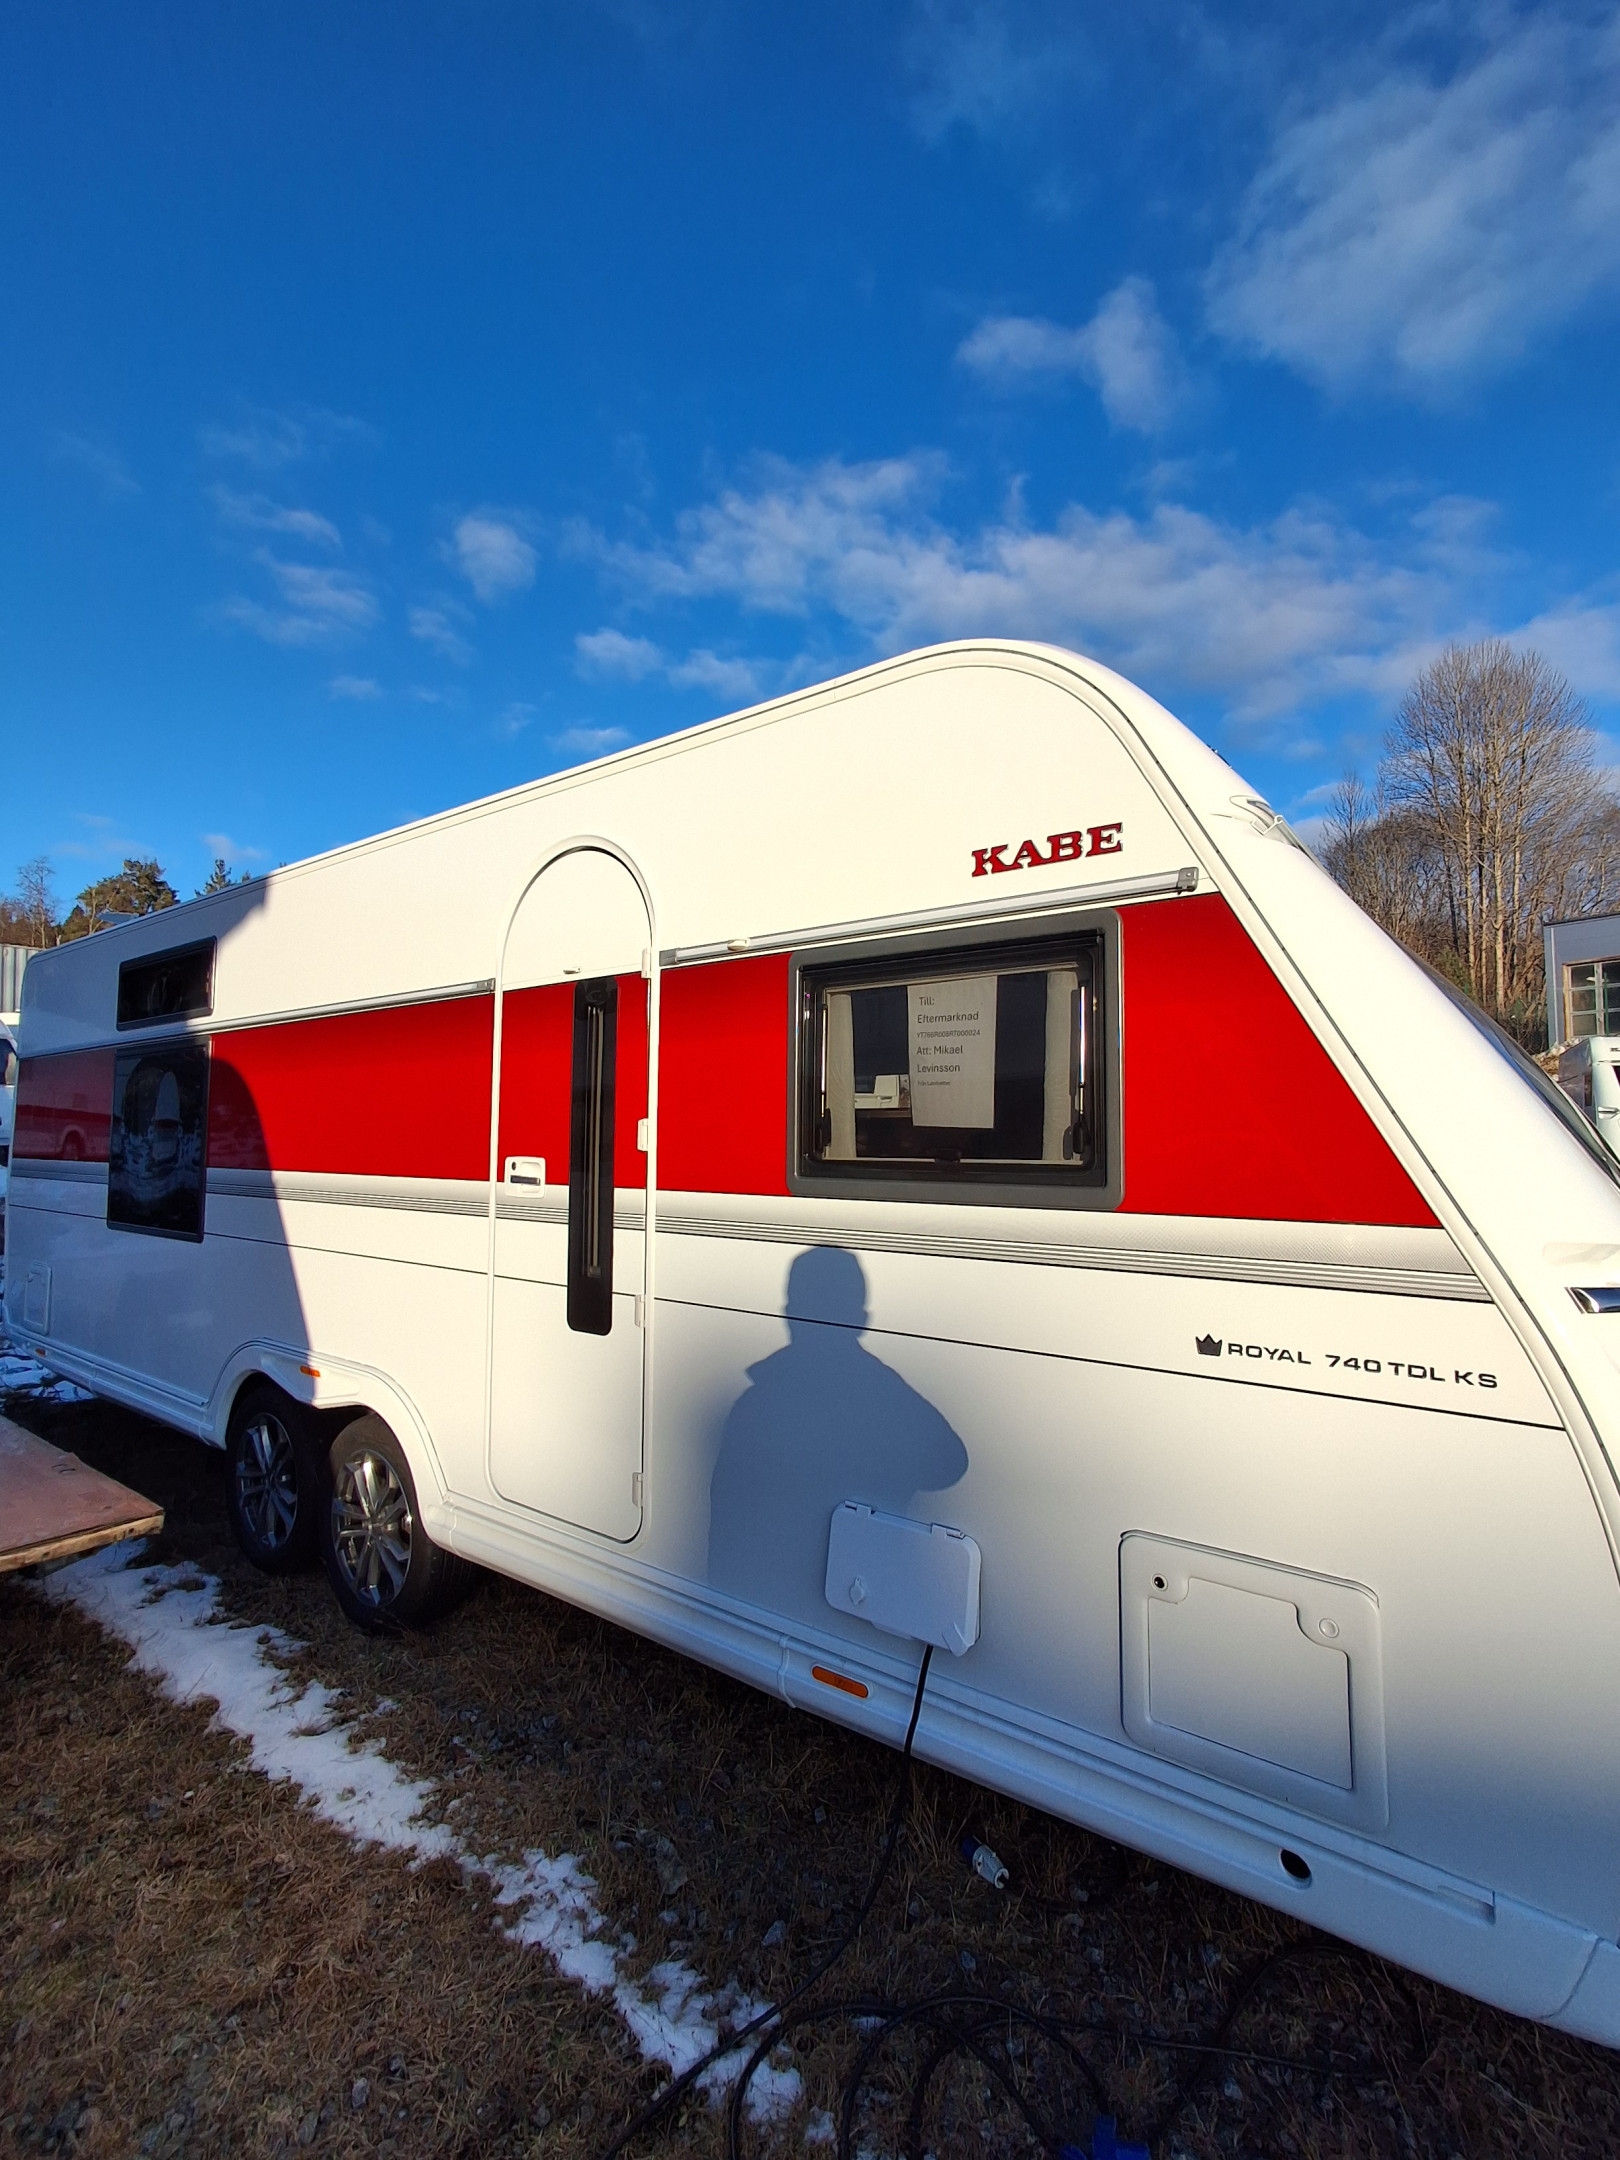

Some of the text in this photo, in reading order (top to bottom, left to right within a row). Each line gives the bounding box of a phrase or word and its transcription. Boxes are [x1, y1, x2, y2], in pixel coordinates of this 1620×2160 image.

[971, 822, 1123, 877] KABE
[919, 997, 935, 1006] Till:
[917, 1011, 979, 1024] Eftermarknad
[933, 1045, 963, 1055] Mikael
[917, 1063, 961, 1073] Levinsson
[1228, 1342, 1498, 1389] ROYAL 740 TDL KS
